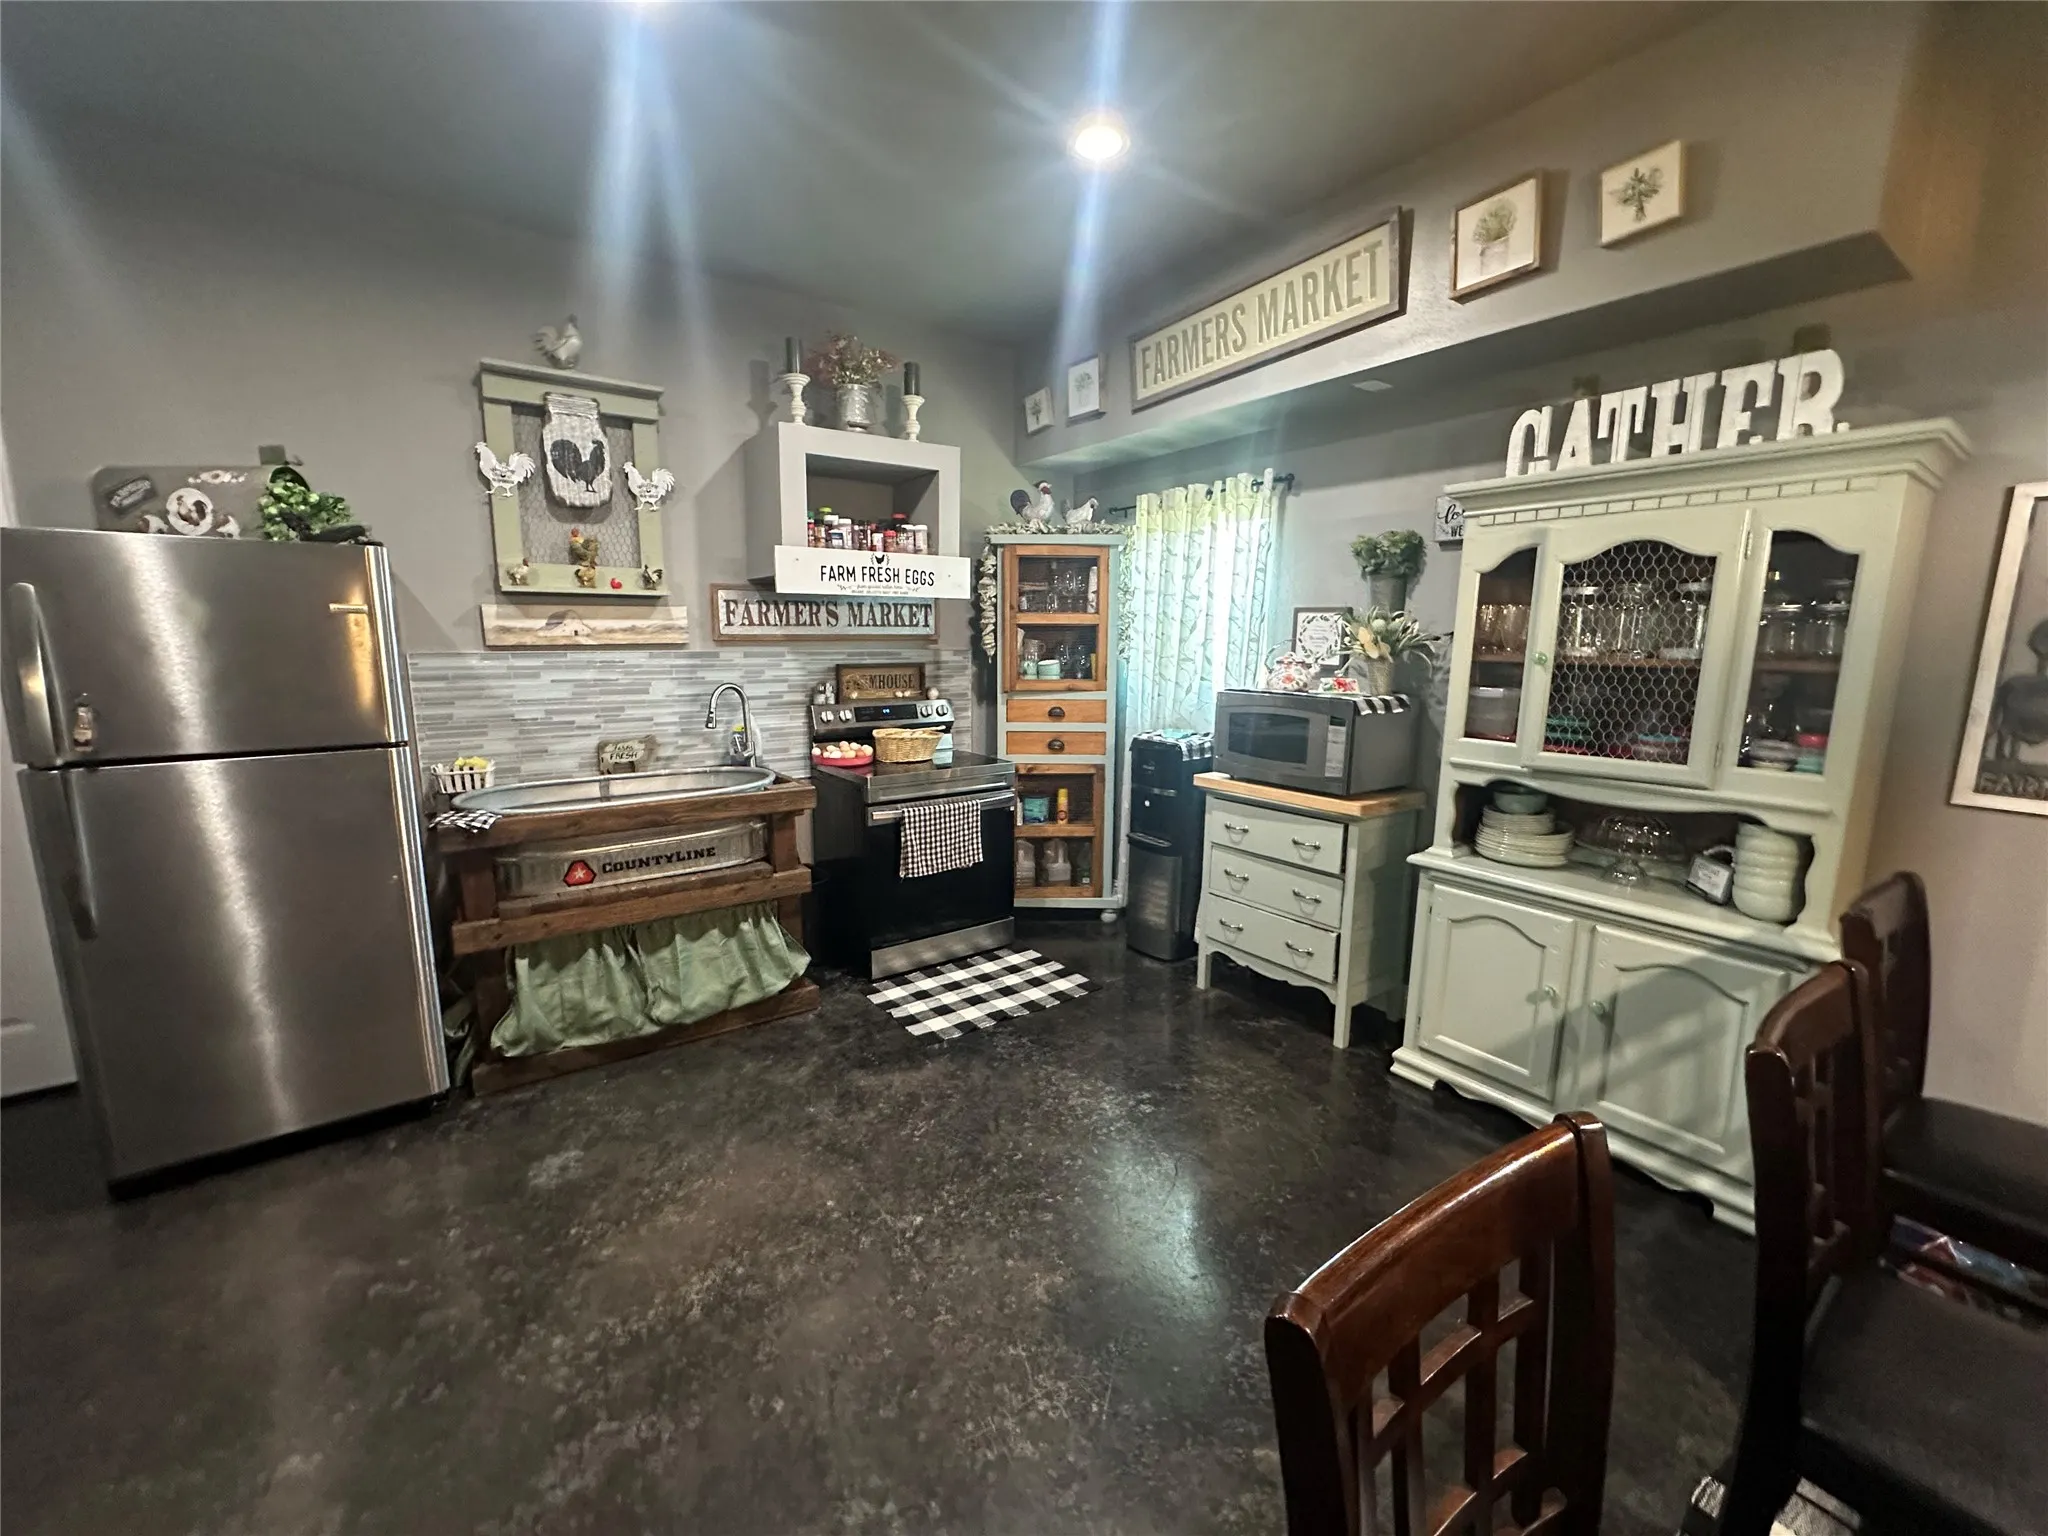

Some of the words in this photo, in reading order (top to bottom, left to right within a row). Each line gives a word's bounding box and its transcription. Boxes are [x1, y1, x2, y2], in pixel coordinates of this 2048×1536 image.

[1140, 302, 1247, 390] FARMERS
[1256, 239, 1383, 344] MARKET
[1505, 349, 1850, 478] GATHER
[820, 565, 856, 582] FARM
[861, 566, 900, 584] FRESH
[905, 568, 935, 587] EGGS
[723, 598, 839, 628] FARMER'S
[847, 601, 933, 629] MARKET
[602, 846, 716, 874] COUNTYLINE
